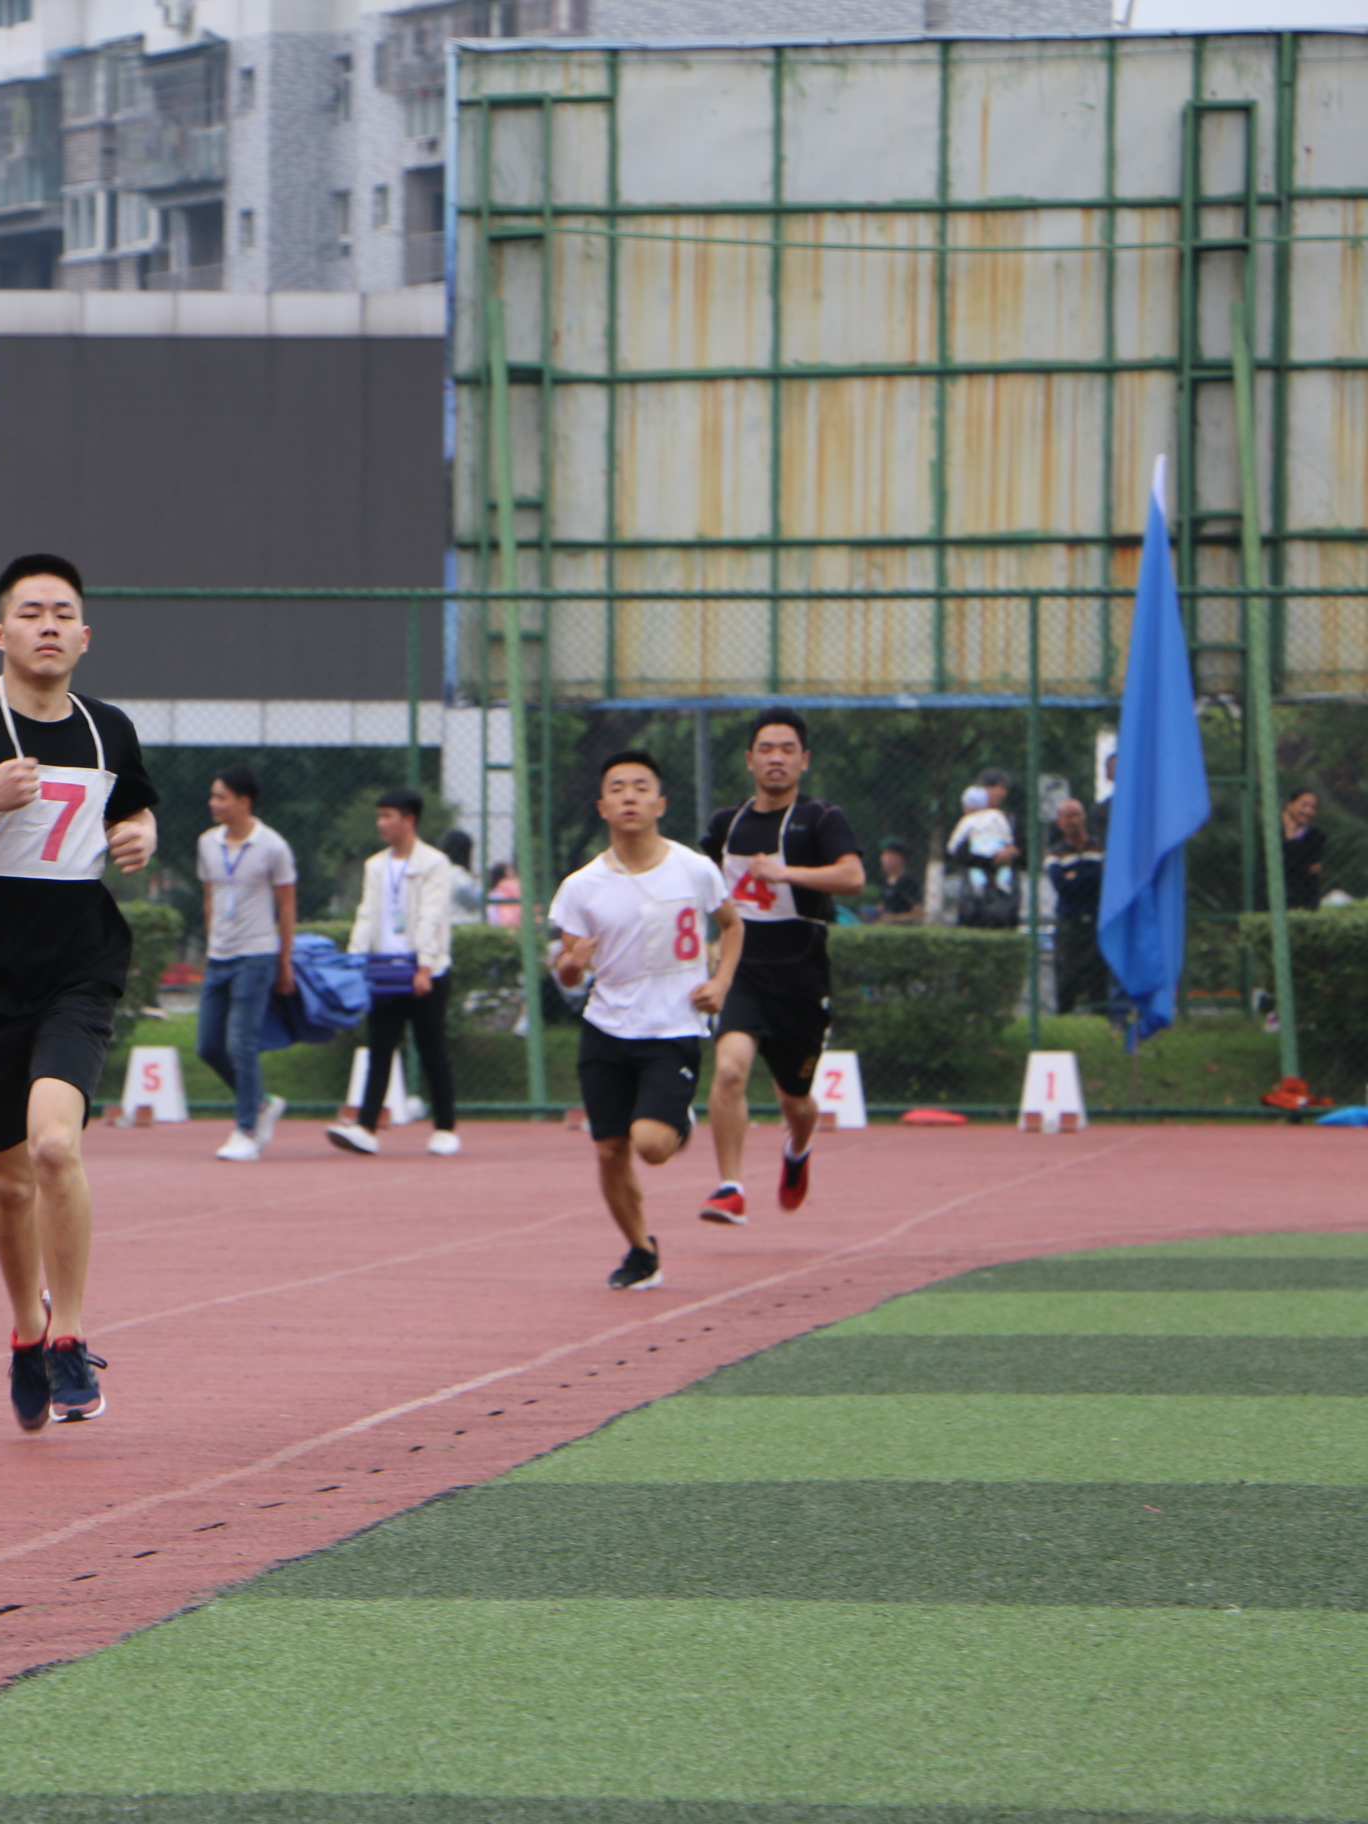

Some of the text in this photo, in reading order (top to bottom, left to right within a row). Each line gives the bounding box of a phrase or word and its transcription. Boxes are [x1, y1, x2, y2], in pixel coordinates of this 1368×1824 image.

[40, 780, 86, 862] 7
[733, 867, 777, 911] 4
[674, 906, 700, 961] 8
[142, 1062, 162, 1092] 5
[824, 1069, 844, 1100] 2
